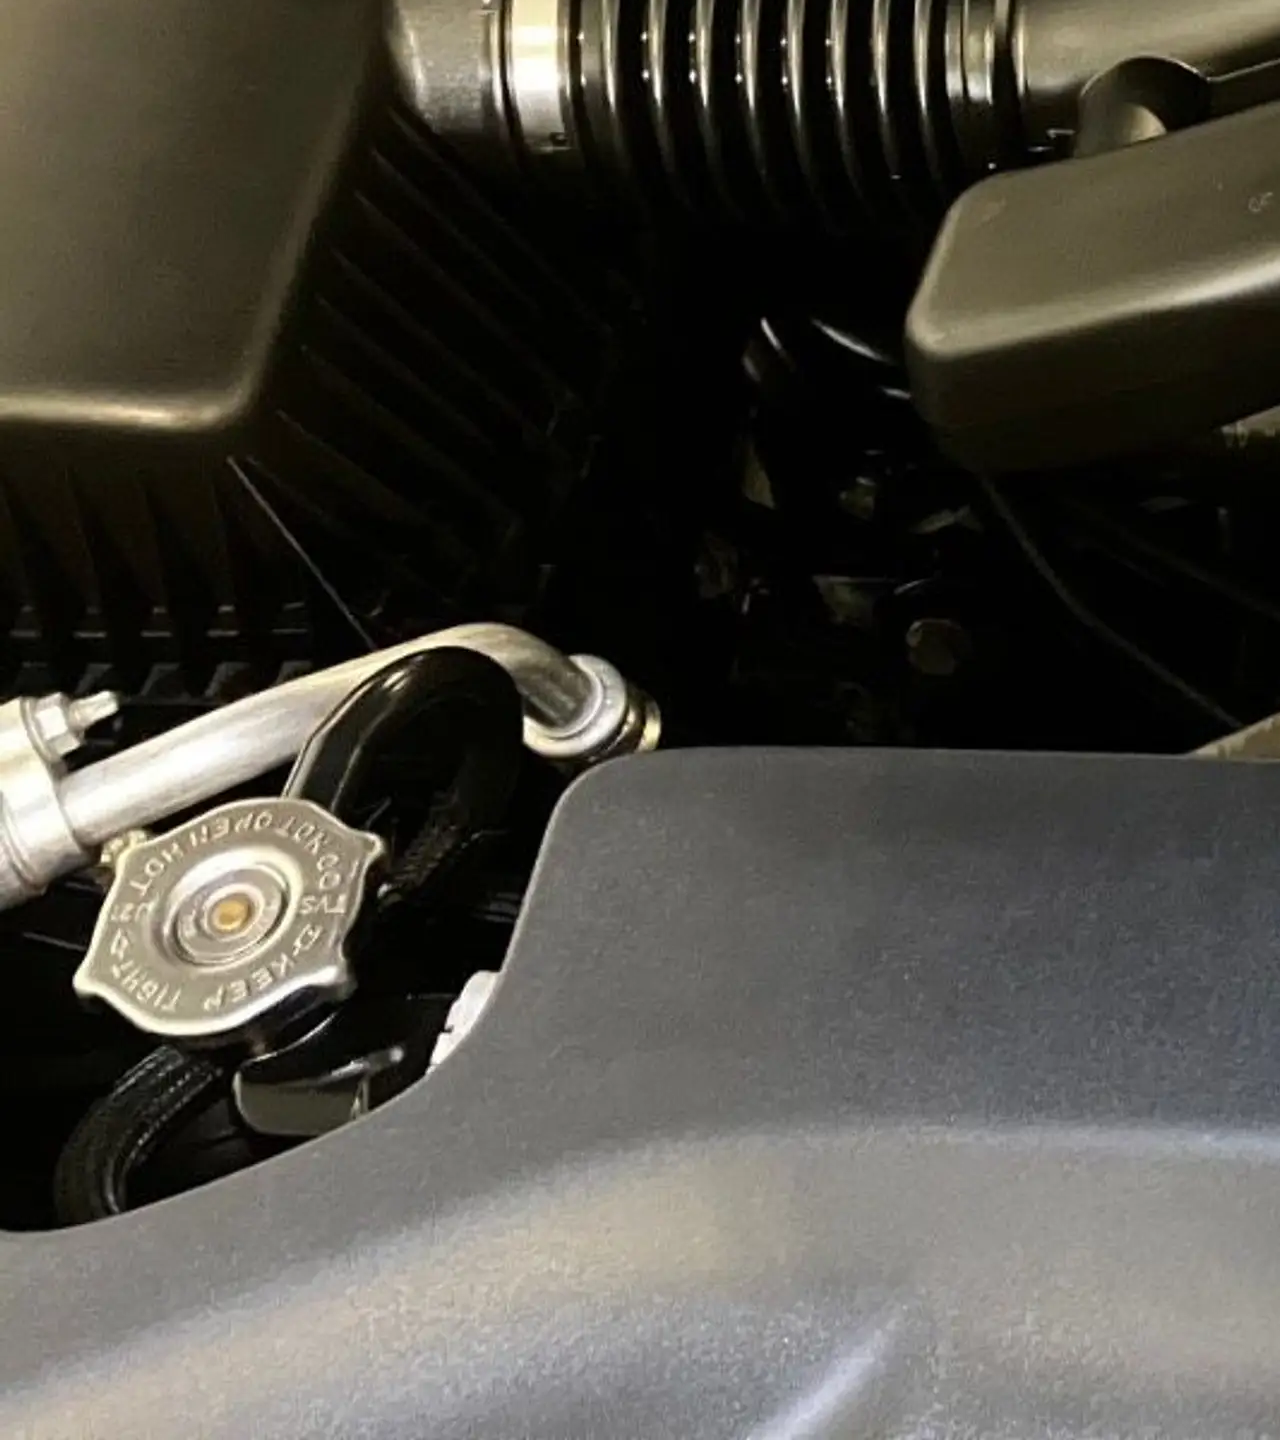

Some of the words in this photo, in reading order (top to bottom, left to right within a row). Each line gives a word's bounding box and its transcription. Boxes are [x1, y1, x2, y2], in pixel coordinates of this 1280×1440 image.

[129, 841, 185, 898] HOT
[111, 959, 183, 1012] TIGHT
[203, 951, 296, 1012] KEEP
